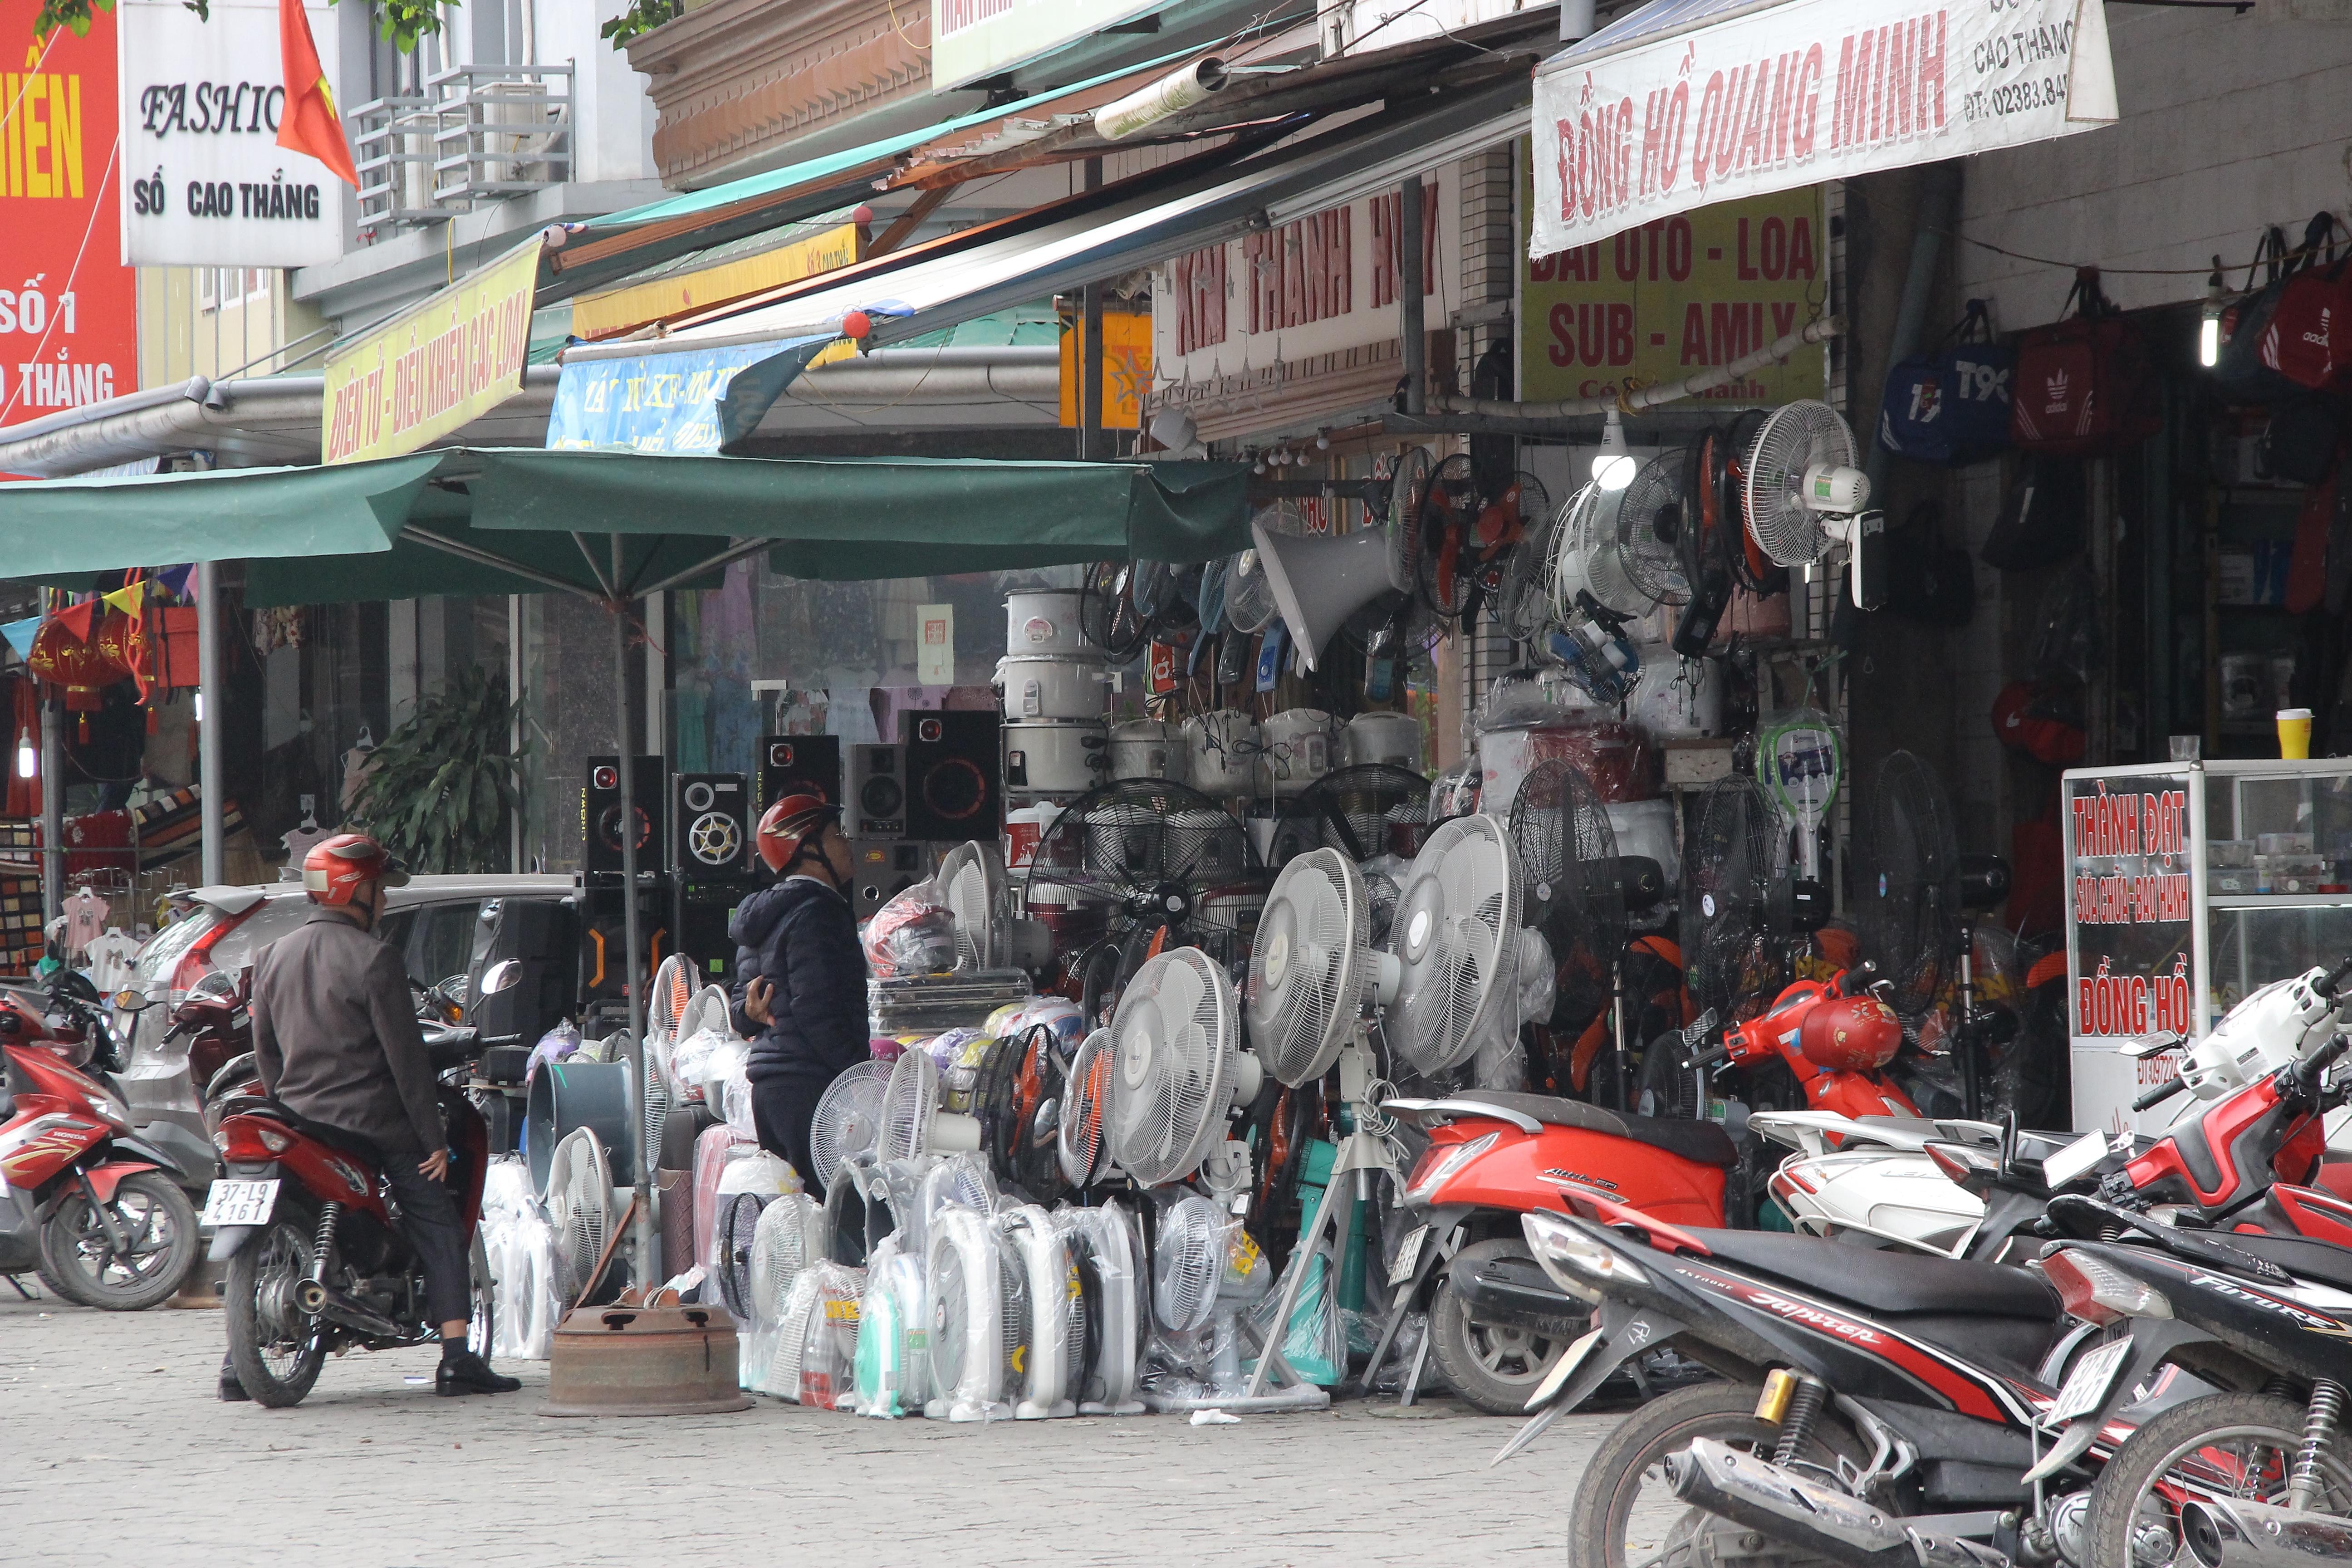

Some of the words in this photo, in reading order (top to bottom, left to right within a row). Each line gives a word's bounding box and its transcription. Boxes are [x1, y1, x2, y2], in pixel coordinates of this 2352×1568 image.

[1974, 36, 2009, 74] CAO
[0, 34, 83, 198] IỀN
[140, 81, 286, 138] FASHIO
[1557, 70, 1634, 224] ĐỒNG
[1639, 41, 1695, 199] HỒ
[1694, 42, 1823, 201] QUANG
[1831, 10, 1948, 152] MINH
[1992, 74, 2068, 116] 02383.84
[134, 165, 165, 216] SỐ
[187, 181, 233, 218] CAO
[239, 168, 320, 220] THẮNG
[1243, 205, 1351, 335] THANH
[1737, 216, 1814, 281] LOA
[0, 273, 45, 334] SỐ
[58, 291, 75, 334] 1
[393, 323, 425, 435] ĐIỀU
[427, 294, 467, 420] KHIỂN
[469, 293, 495, 397] CÁC
[1548, 303, 1634, 367] SUB
[19, 347, 113, 406] THẮNG
[2073, 779, 2140, 858] THÀNH
[2143, 790, 2185, 868] ĐẠT
[2078, 955, 2146, 1036] ĐỒNG
[2155, 952, 2189, 1036] HỒ
[53, 1131, 88, 1141] HONDA
[2190, 1274, 2337, 1329] FUTURE
[2054, 1377, 2104, 1420] 9247
